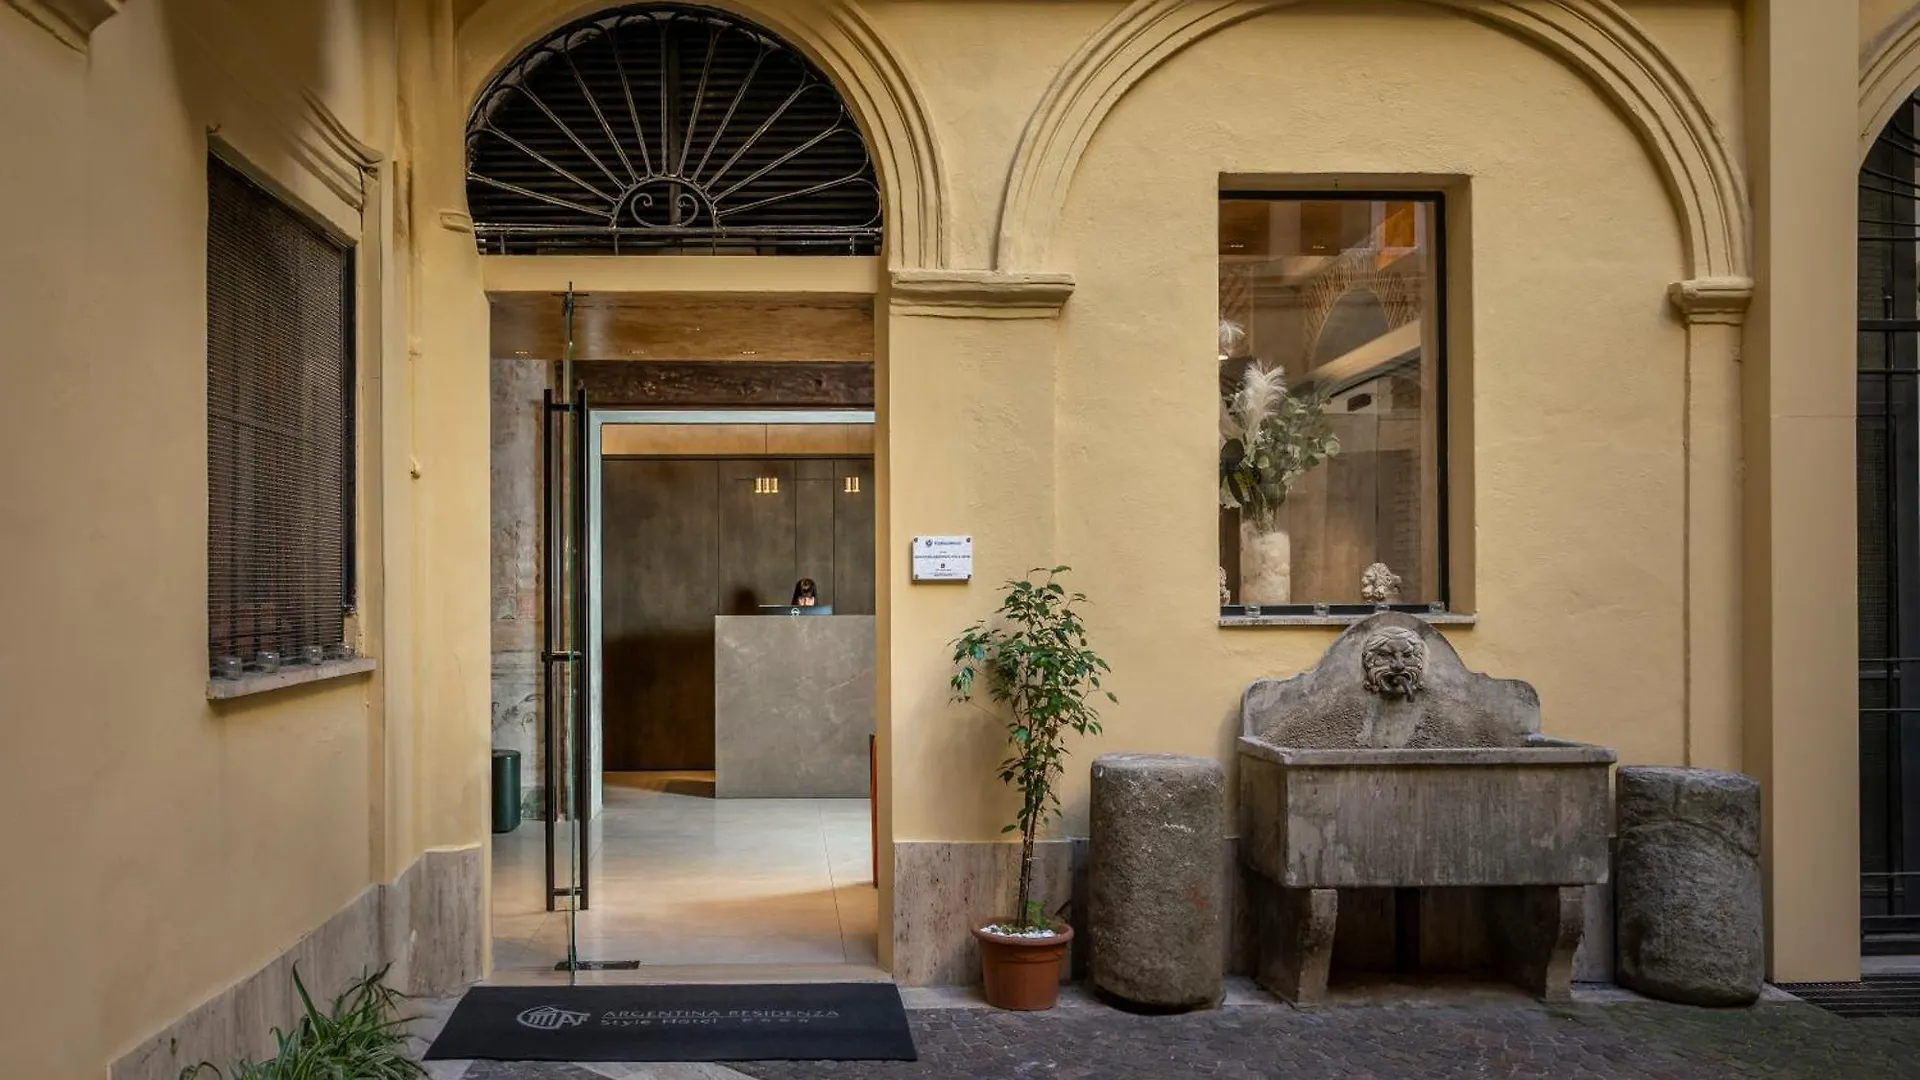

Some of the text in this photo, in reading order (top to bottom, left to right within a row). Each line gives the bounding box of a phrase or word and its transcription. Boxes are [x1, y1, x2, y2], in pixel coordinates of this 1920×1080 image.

[602, 1010, 840, 1018] ARGENTINA RESIDENZA
[600, 1019, 651, 1027] Style
